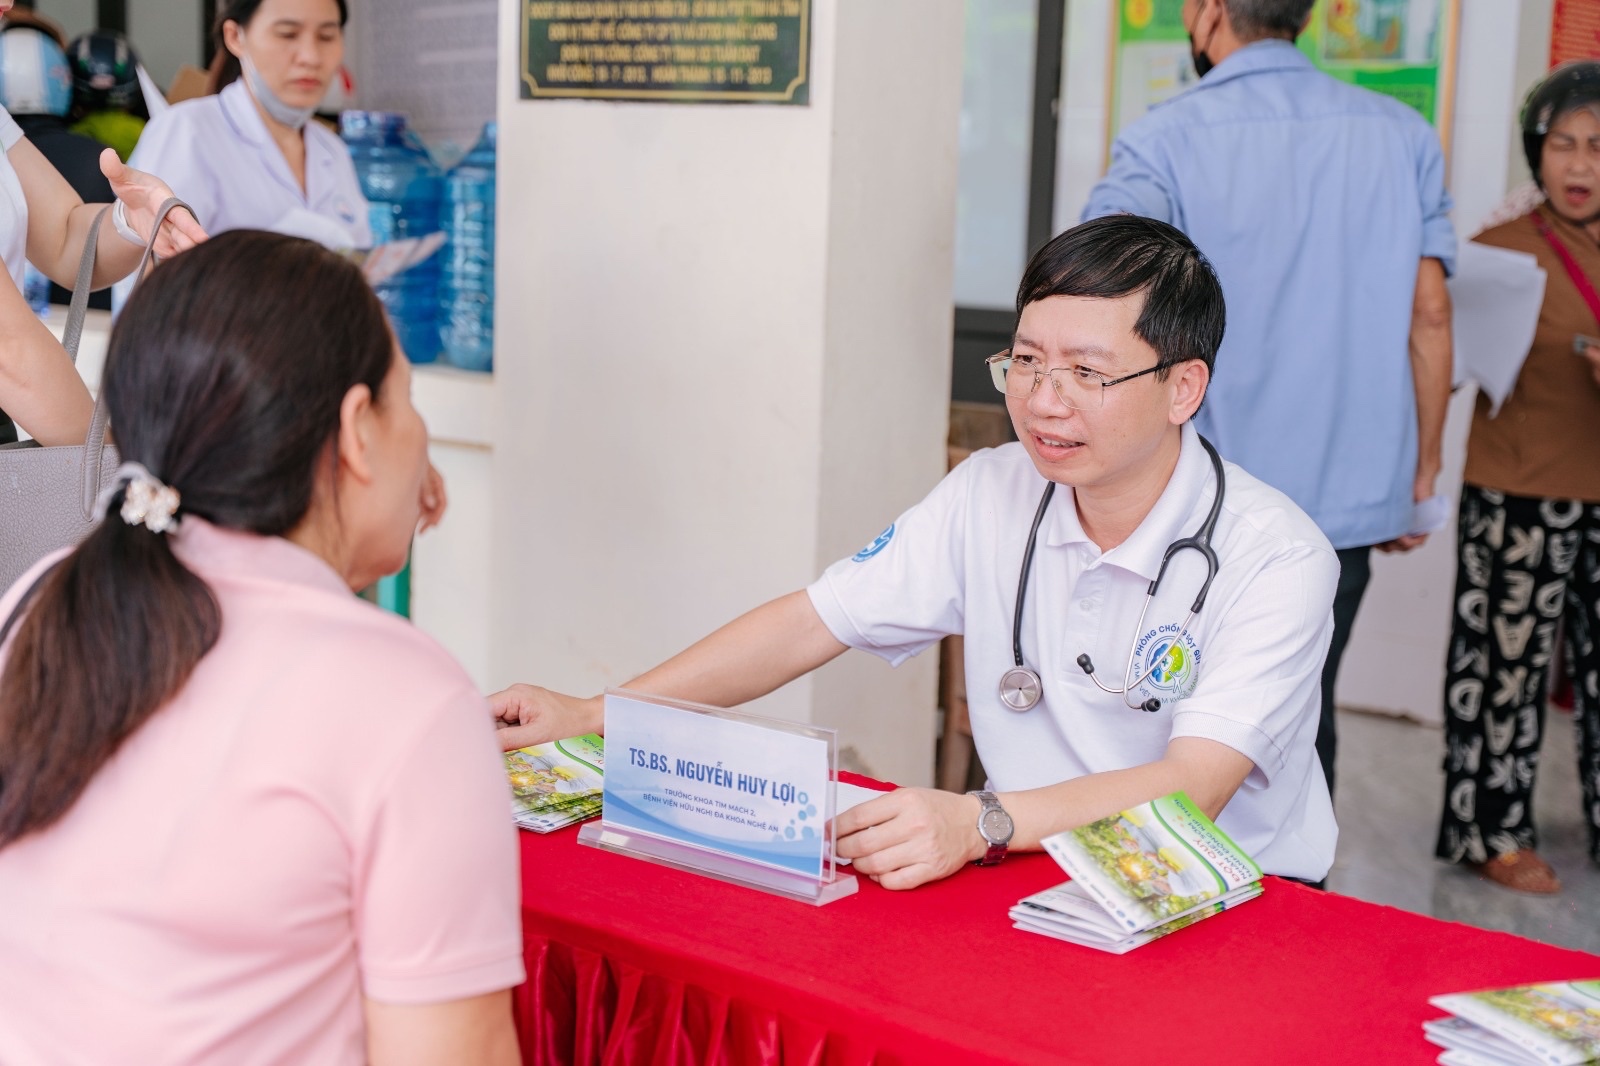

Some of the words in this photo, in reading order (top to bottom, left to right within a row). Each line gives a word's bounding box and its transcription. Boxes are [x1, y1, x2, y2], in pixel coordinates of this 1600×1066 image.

[629, 747, 671, 774] TS.BS.
[676, 759, 733, 789] NGUYỄN
[737, 773, 768, 797] HUY
[772, 781, 796, 806] LỢI
[693, 795, 714, 806] KHOA
[714, 800, 727, 809] TIM
[725, 814, 745, 825] KHOA
[767, 824, 779, 833] AN
